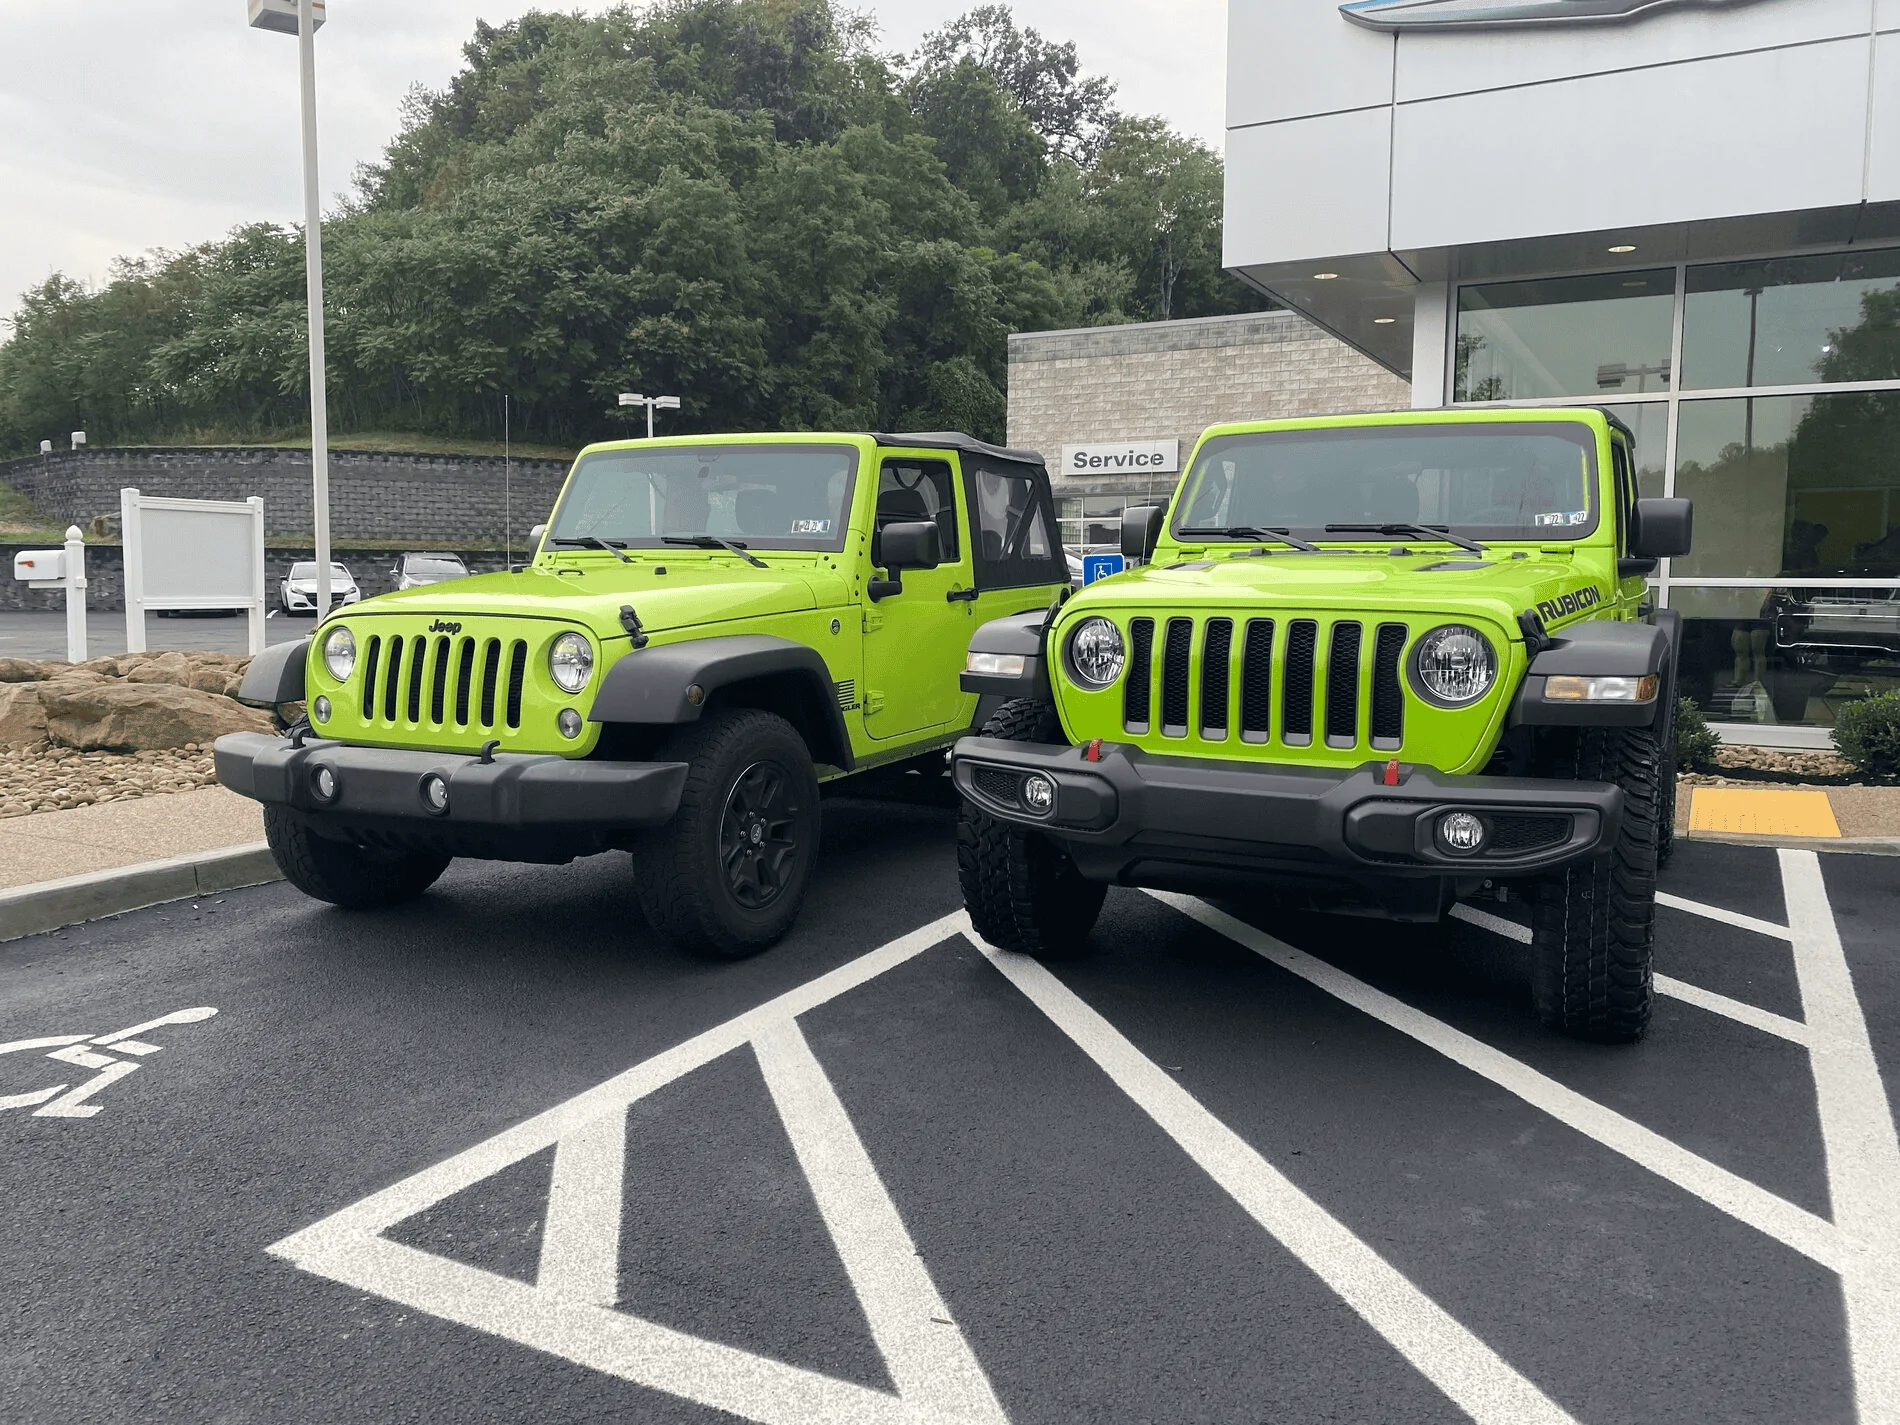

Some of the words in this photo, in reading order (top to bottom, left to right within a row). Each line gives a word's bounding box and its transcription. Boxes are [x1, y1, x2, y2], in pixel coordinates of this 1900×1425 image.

[1073, 450, 1164, 468] Service
[1536, 584, 1601, 622] RUBICON
[428, 619, 462, 635] Jeep
[841, 702, 861, 712] GLER
